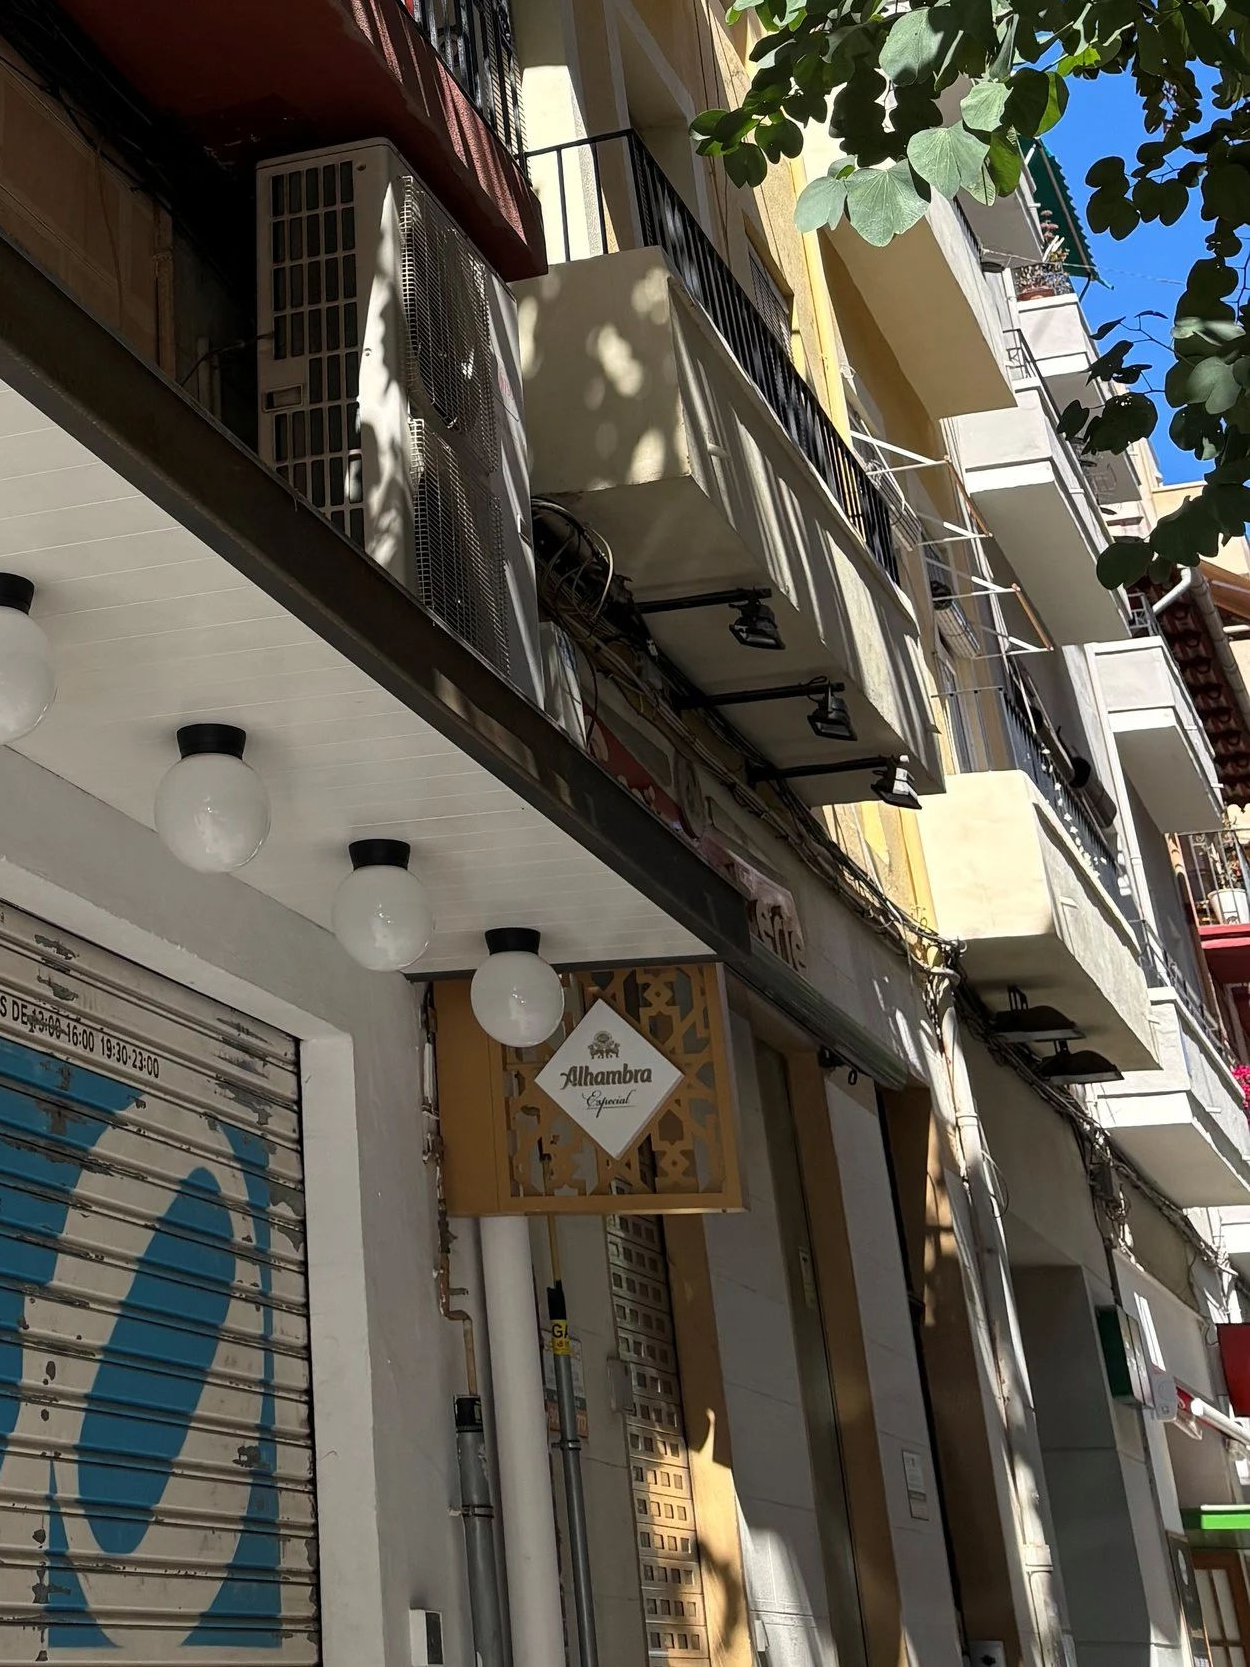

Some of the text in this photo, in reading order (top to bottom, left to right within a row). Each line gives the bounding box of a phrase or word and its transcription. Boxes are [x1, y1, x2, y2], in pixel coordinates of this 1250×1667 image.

[12, 999, 28, 1026] DE
[560, 1063, 652, 1090] Alhambra
[582, 1090, 636, 1118] Especial
